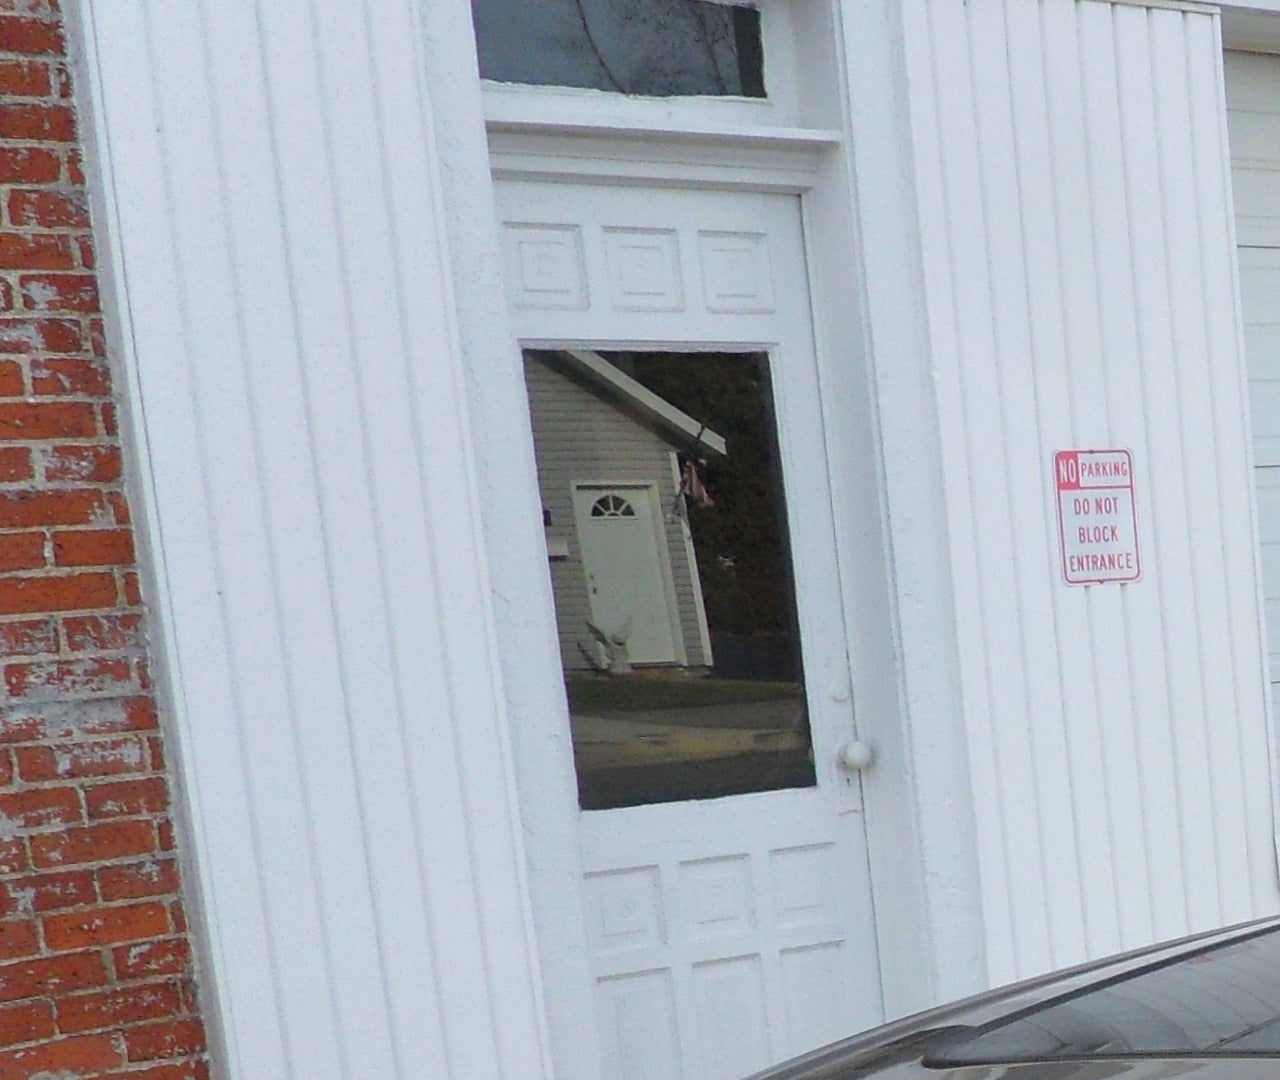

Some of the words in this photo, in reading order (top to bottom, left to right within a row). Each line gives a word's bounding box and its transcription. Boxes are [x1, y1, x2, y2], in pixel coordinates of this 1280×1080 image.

[1059, 459, 1077, 483] NO
[1081, 462, 1128, 477] PARKING
[1074, 498, 1090, 515] DO
[1095, 497, 1119, 515] NOT
[1078, 525, 1119, 544] BLOCK
[1069, 553, 1133, 573] ENTRANCE
